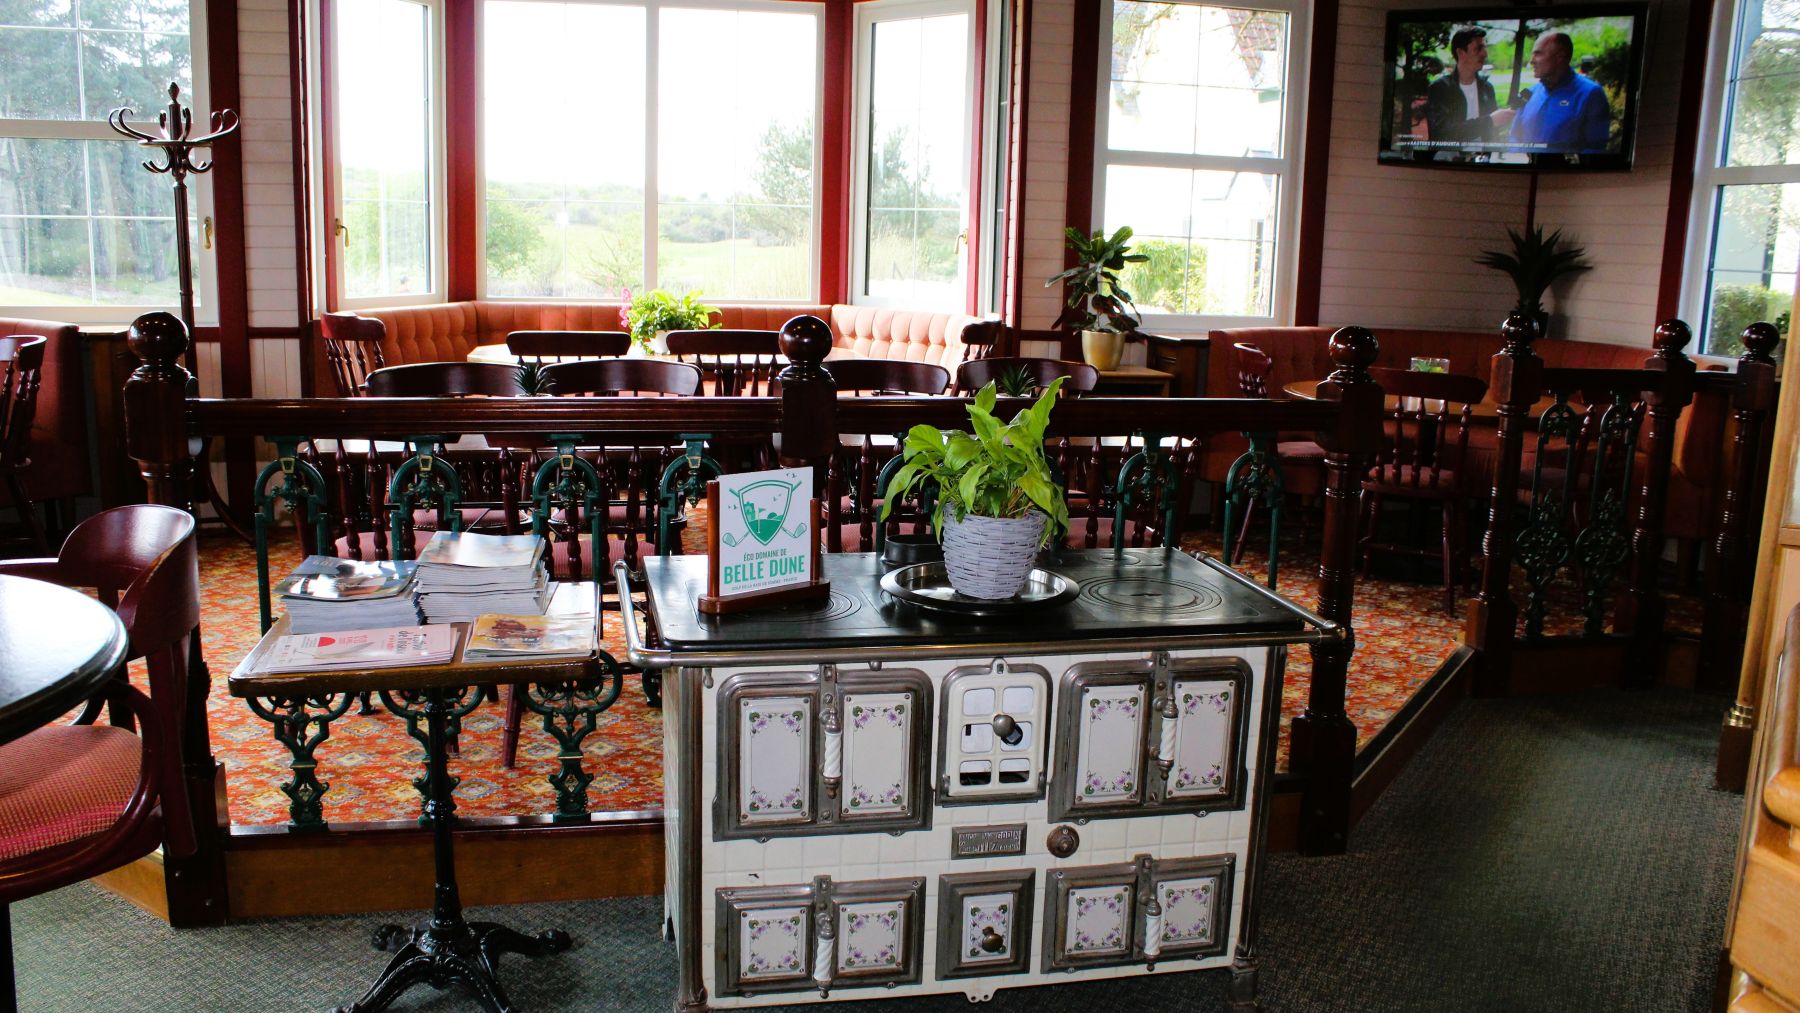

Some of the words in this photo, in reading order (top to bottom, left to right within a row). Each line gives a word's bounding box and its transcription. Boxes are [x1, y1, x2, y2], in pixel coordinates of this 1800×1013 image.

[744, 552, 754, 562] ÉCO
[756, 550, 778, 560] DOMAINE
[723, 561, 764, 585] BELLE
[769, 555, 805, 577] DUNE
